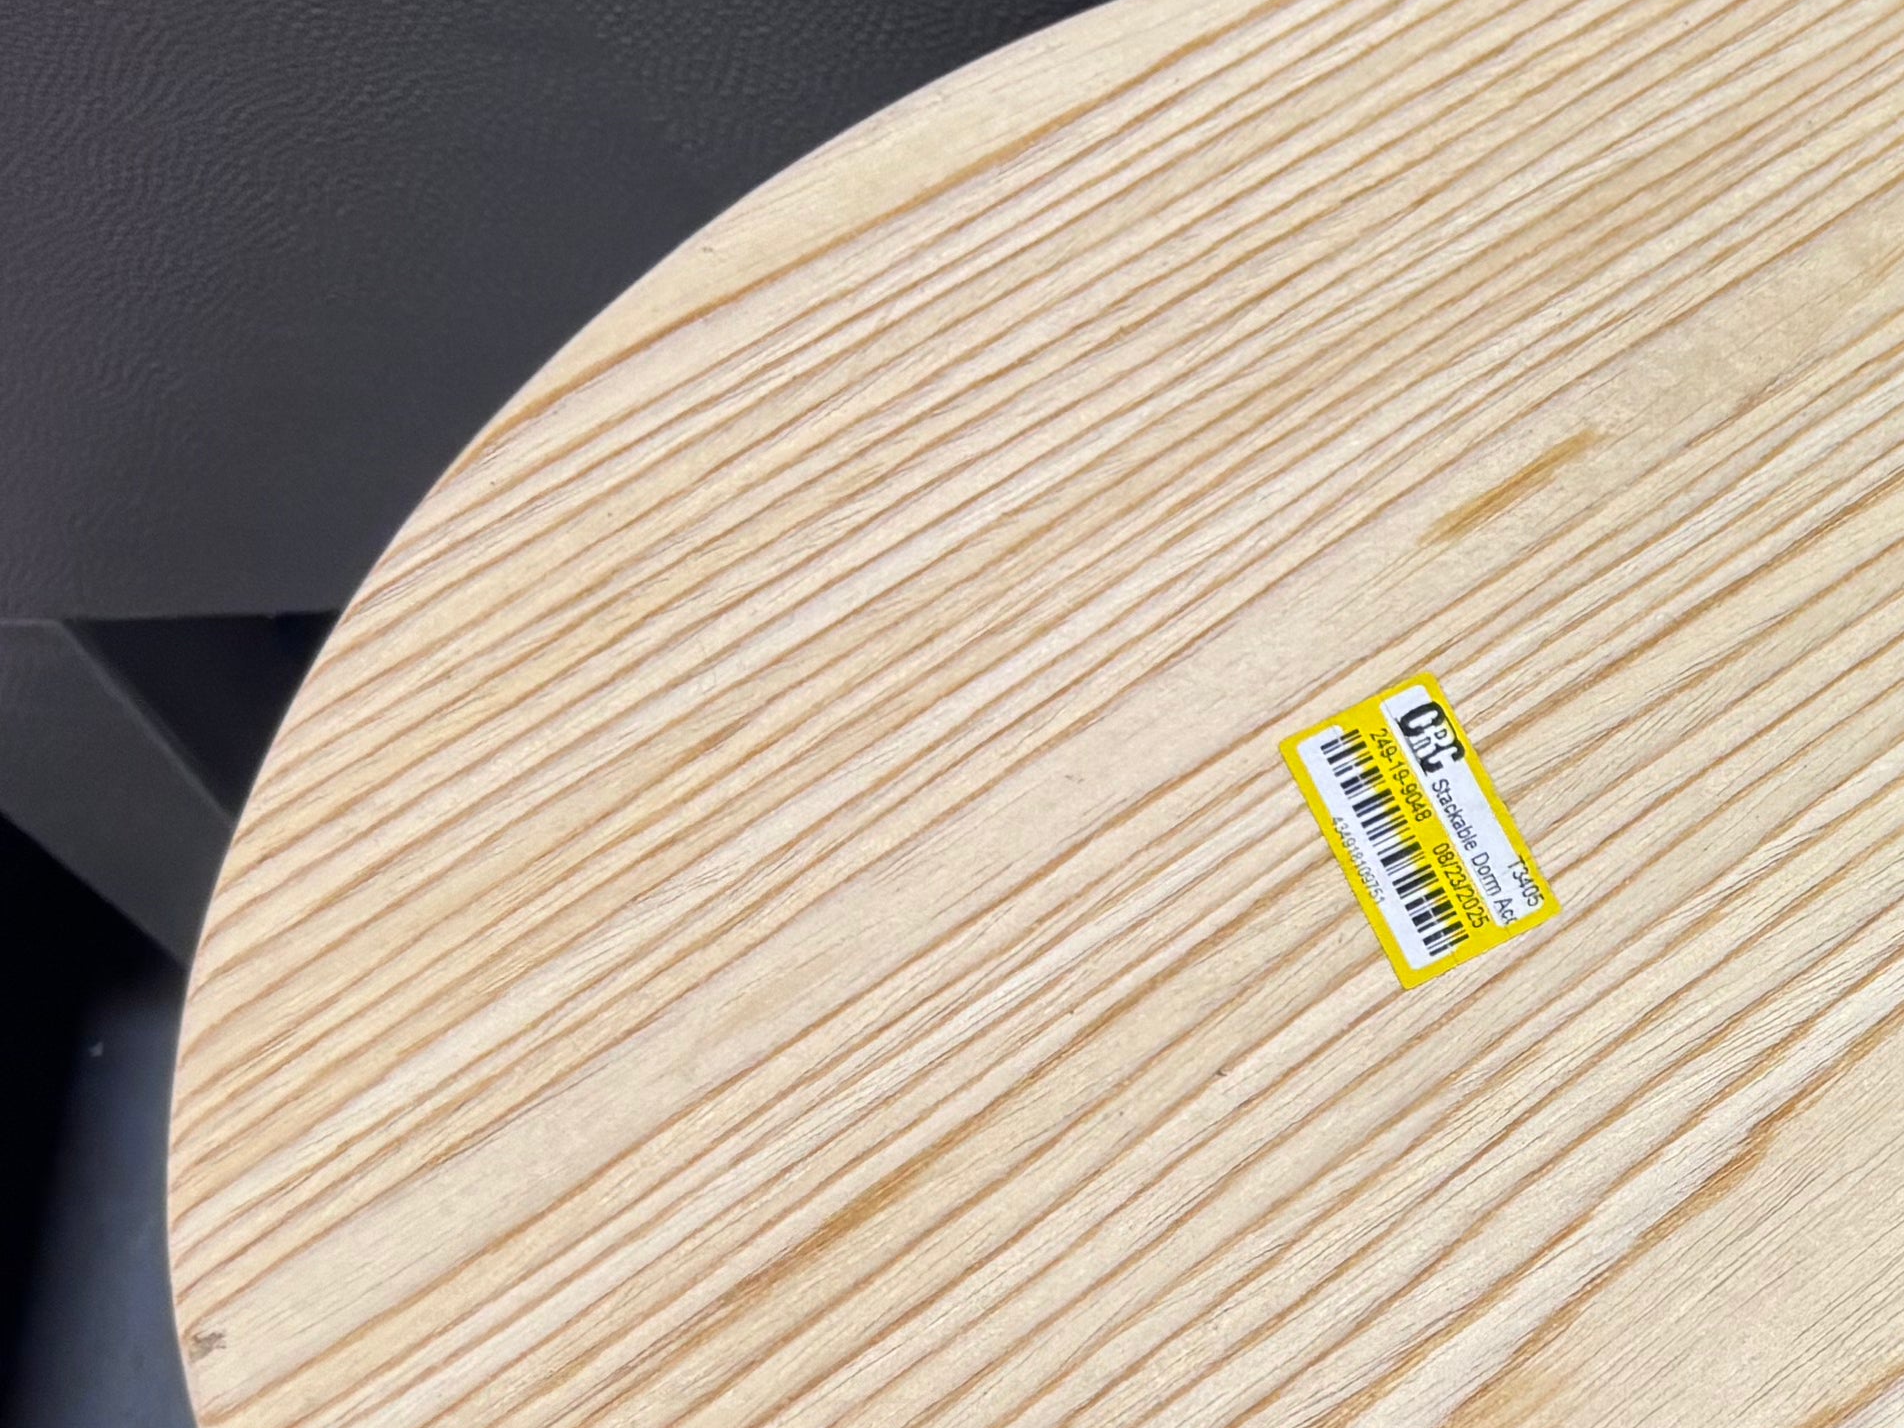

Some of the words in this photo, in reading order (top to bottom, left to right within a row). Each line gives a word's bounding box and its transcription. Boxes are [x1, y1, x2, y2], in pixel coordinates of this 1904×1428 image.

[1371, 728, 1432, 822] 249-19-9048
[1432, 842, 1490, 929] 08/23/2025
[1432, 778, 1478, 851] Stackable
[1471, 851, 1502, 896] Dorm
[1507, 855, 1544, 907] T3405
